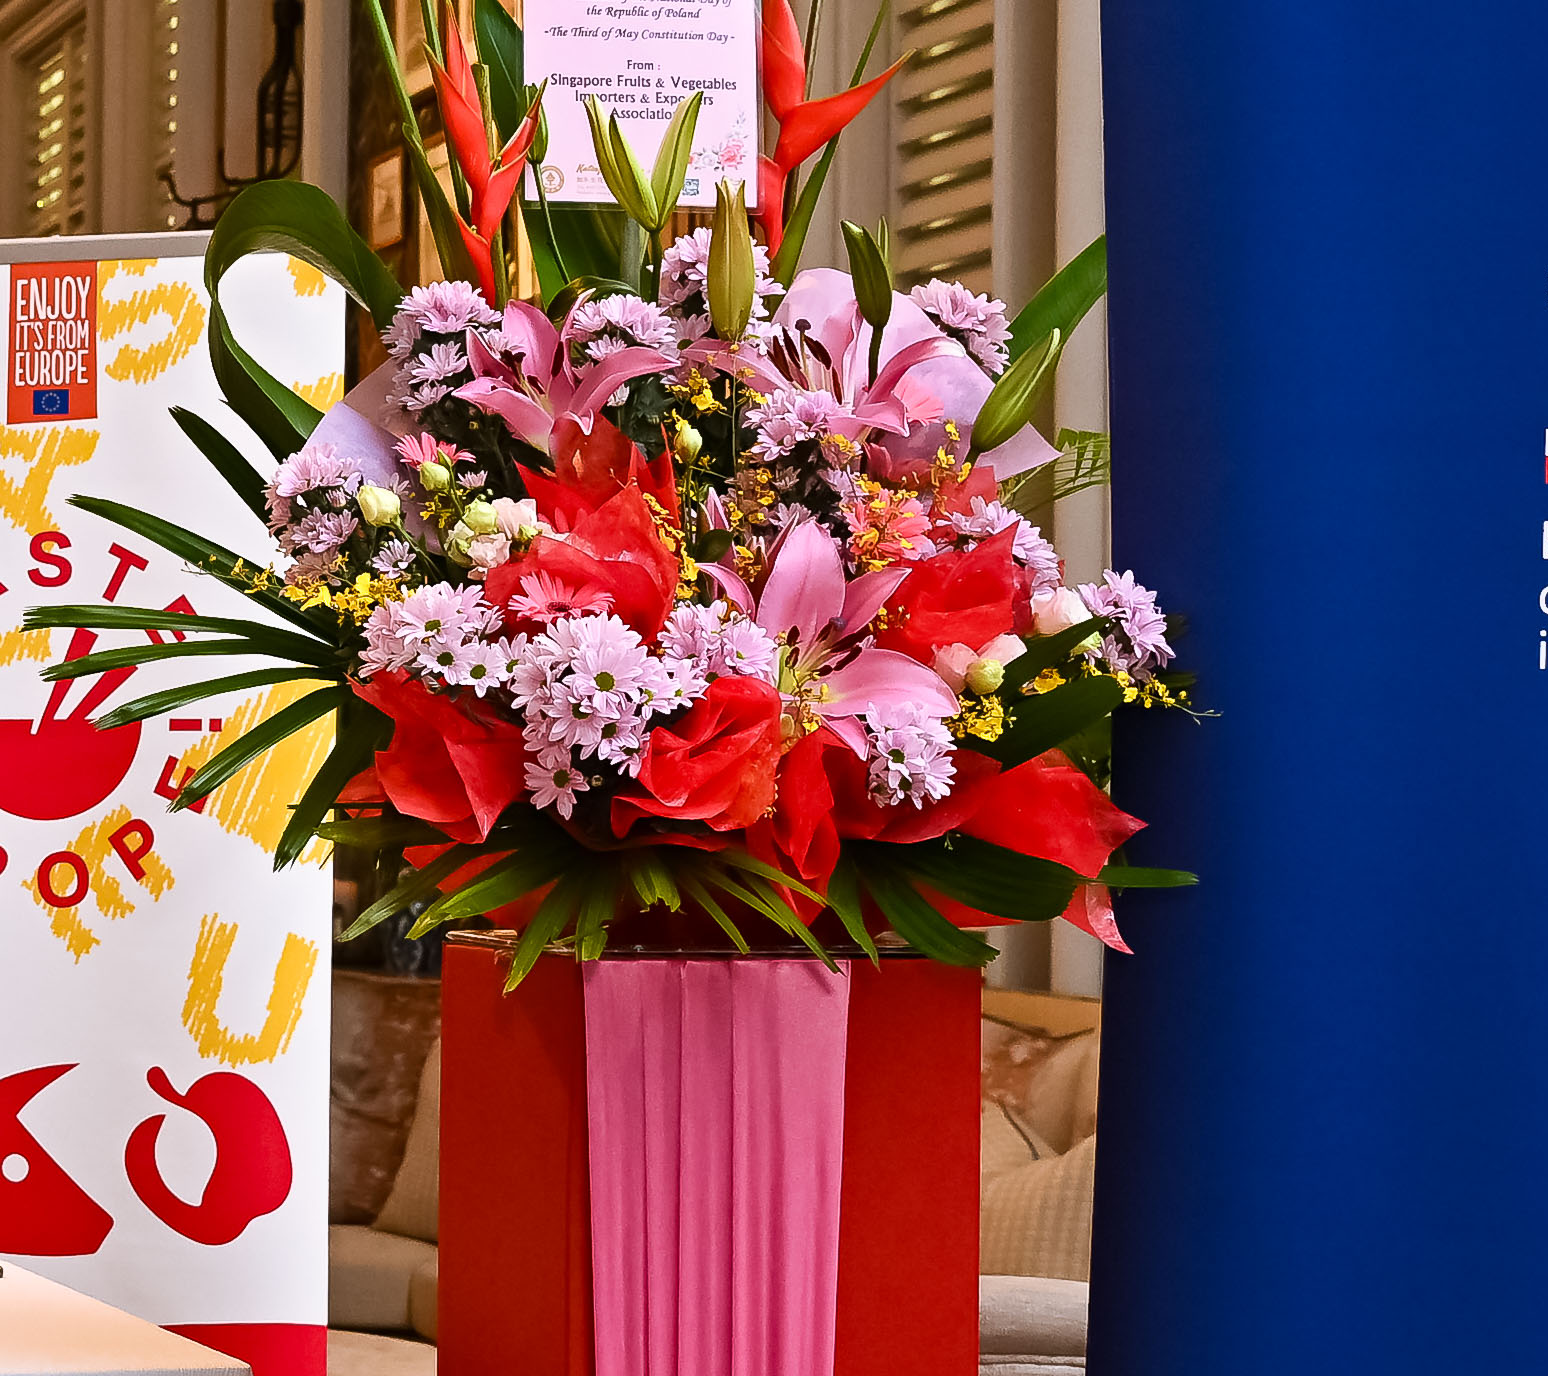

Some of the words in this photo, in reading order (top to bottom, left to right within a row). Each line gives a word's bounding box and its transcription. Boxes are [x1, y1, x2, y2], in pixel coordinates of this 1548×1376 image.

[587, 5, 602, 15] the
[605, 6, 649, 19] Republic
[652, 7, 667, 20] of
[665, 8, 701, 18] Poland
[571, 27, 600, 37] Third
[602, 27, 616, 40] of
[615, 29, 638, 41] May
[642, 30, 703, 40] Constitution
[707, 32, 728, 44] Day
[627, 60, 653, 70] From
[551, 73, 612, 88] Singapore
[618, 75, 650, 87] Fruits
[656, 78, 664, 88] &
[671, 76, 736, 92] Vegetables
[576, 90, 635, 103] Imorters
[640, 94, 650, 103] &
[656, 92, 713, 105] Expors
[612, 107, 672, 119] Associatio
[16, 275, 91, 321] ENJOY
[15, 321, 44, 350] IT'S
[47, 319, 89, 350] FROM
[15, 349, 88, 386] EUROPE
